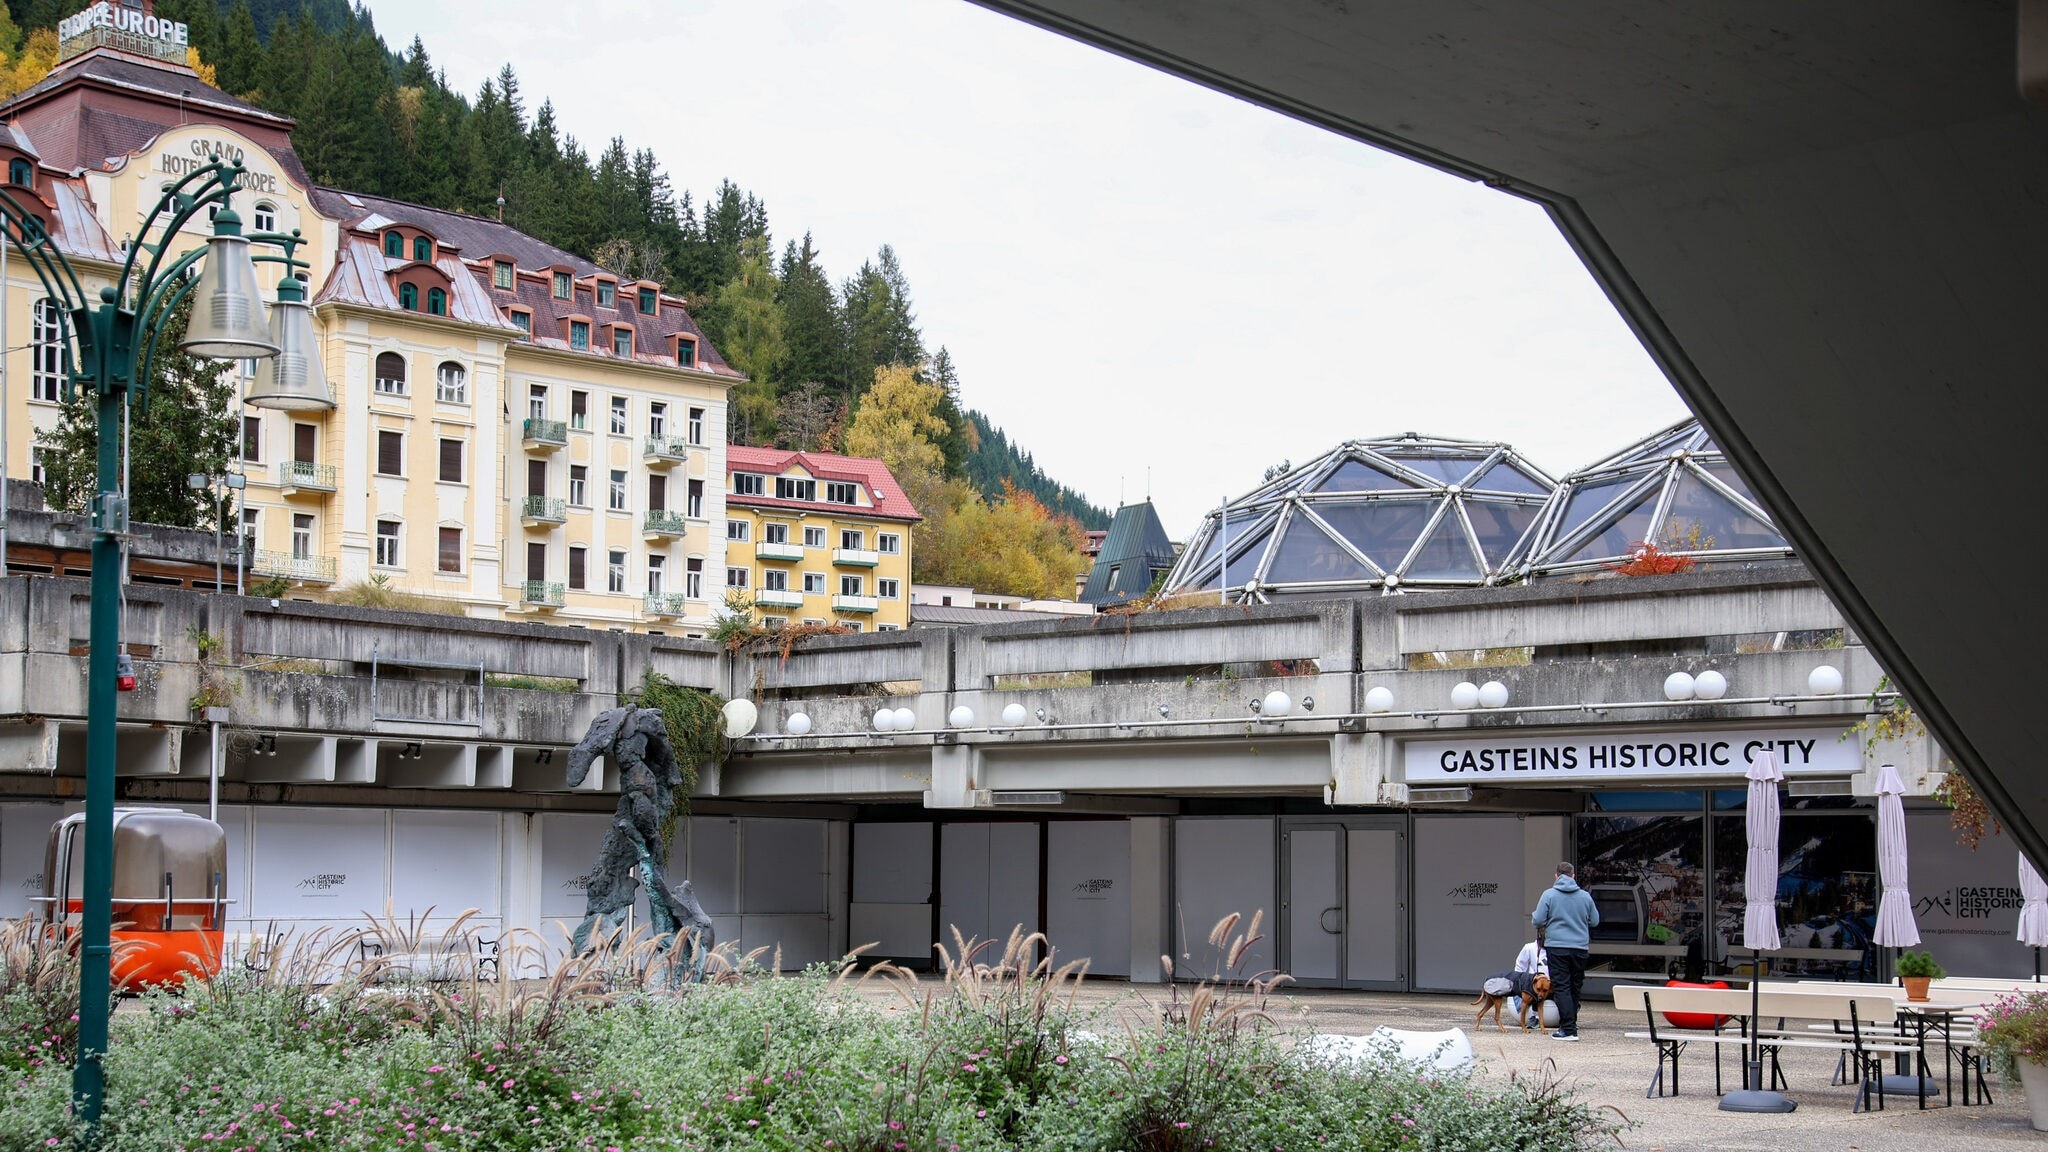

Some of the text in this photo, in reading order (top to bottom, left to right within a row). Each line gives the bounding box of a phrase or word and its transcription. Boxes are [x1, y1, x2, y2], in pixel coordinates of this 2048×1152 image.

[100, 2, 188, 46] EUROPE
[191, 139, 244, 161] GRAND
[1440, 746, 1578, 773] GASTEINS
[1589, 741, 1731, 769] HISTORIC
[1960, 887, 2023, 898] GASTEIN
[1960, 897, 2025, 909] HISTORIC
[1960, 908, 1991, 919] CITY
